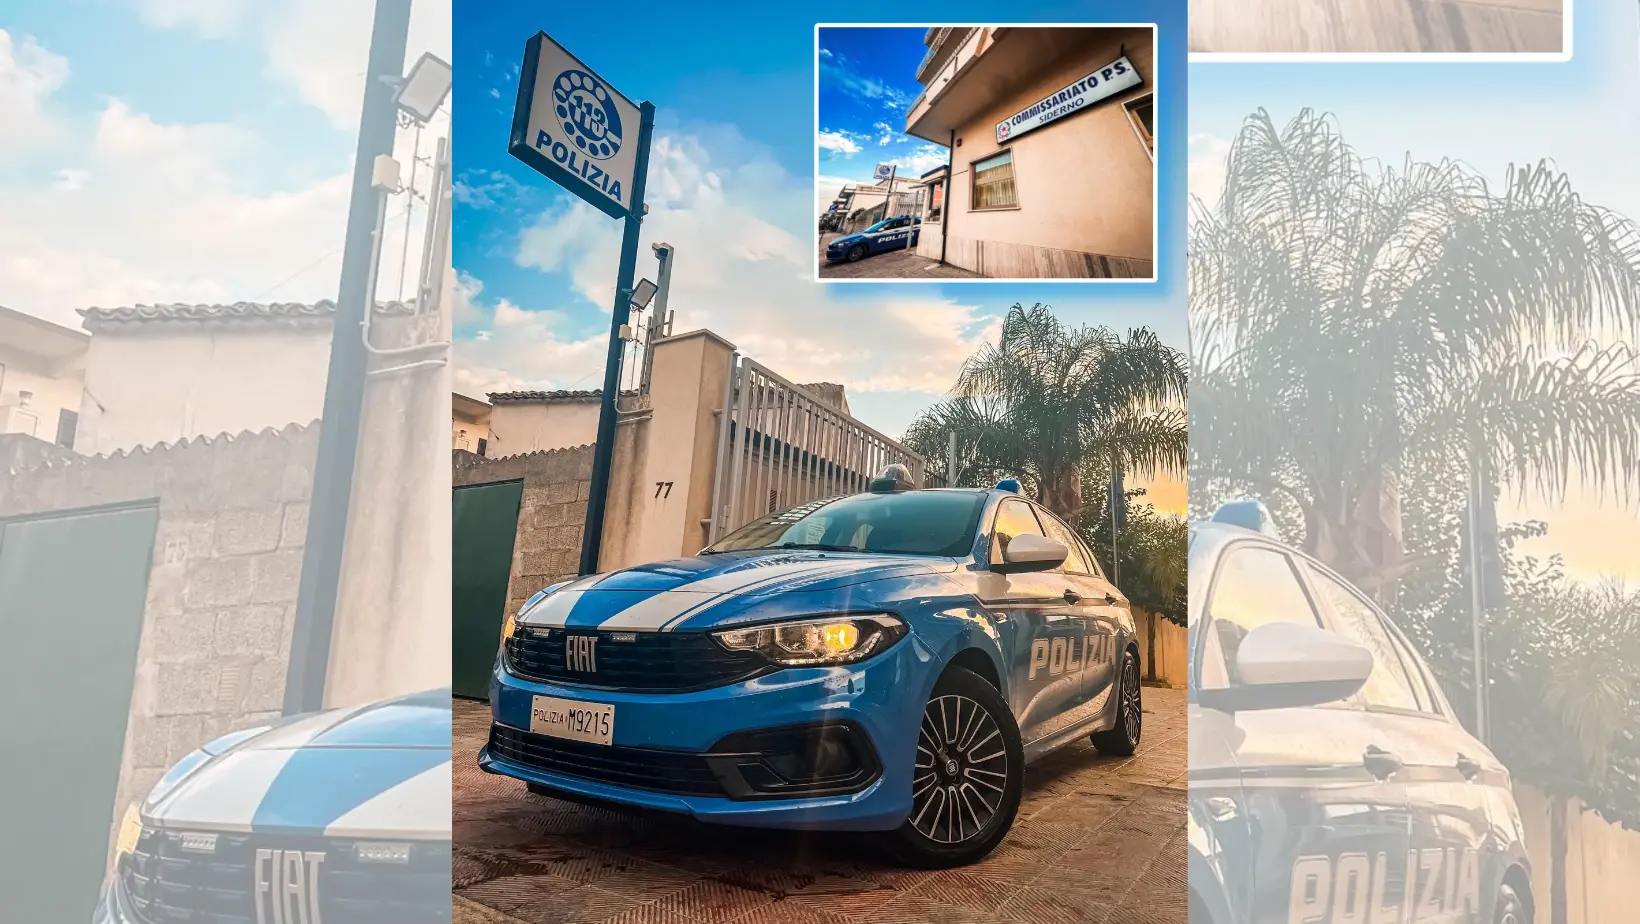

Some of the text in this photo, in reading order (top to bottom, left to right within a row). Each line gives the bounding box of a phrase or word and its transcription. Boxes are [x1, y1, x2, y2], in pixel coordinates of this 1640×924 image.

[1011, 61, 1131, 126] COMMISSARIATO P.S.
[1039, 97, 1084, 123] SIDERNO
[535, 129, 622, 201] POLIZIA
[654, 481, 674, 499] 77
[566, 635, 599, 673] FIAT
[1028, 634, 1116, 681] POLIZIA
[533, 708, 610, 736] POLIZIA M9215
[254, 848, 327, 924] FIAT
[1288, 847, 1480, 924] POLIZIA
